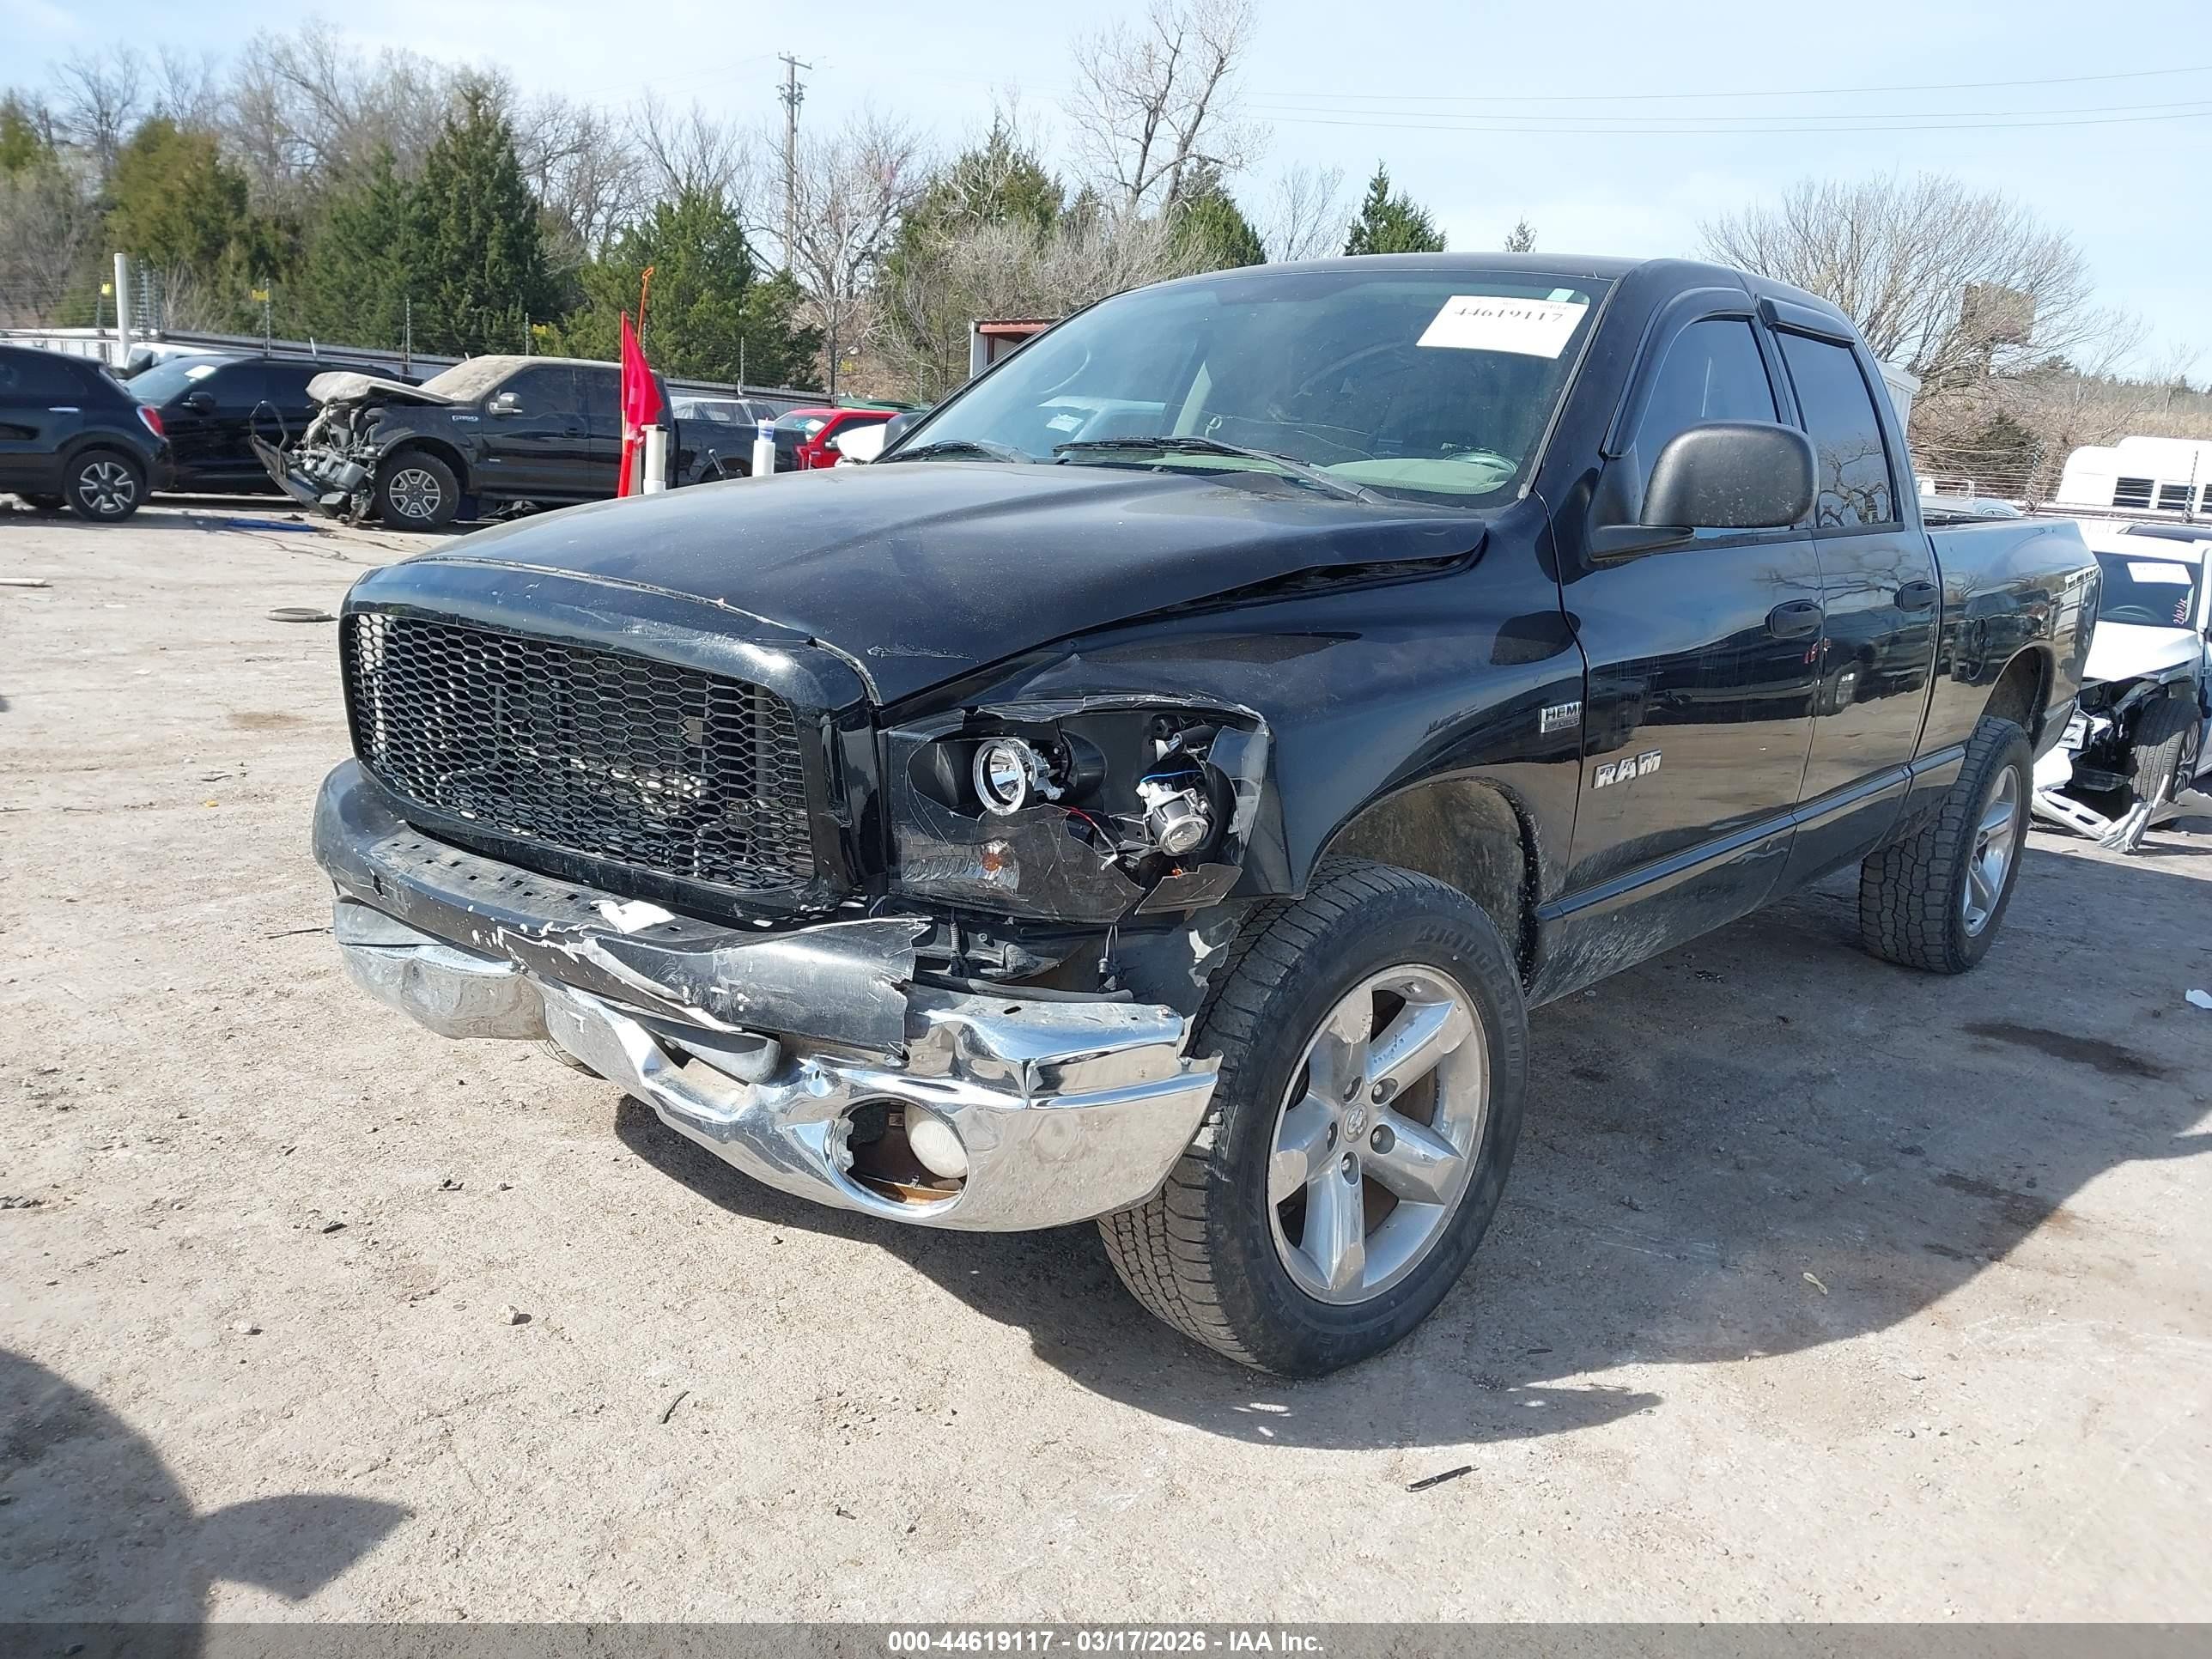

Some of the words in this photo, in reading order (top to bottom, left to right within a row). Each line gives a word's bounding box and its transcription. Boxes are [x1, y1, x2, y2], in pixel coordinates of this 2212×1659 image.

[1455, 308, 1563, 322] 44619117
[1545, 702, 1581, 720] HEMI
[1592, 749, 1662, 789] RAM
